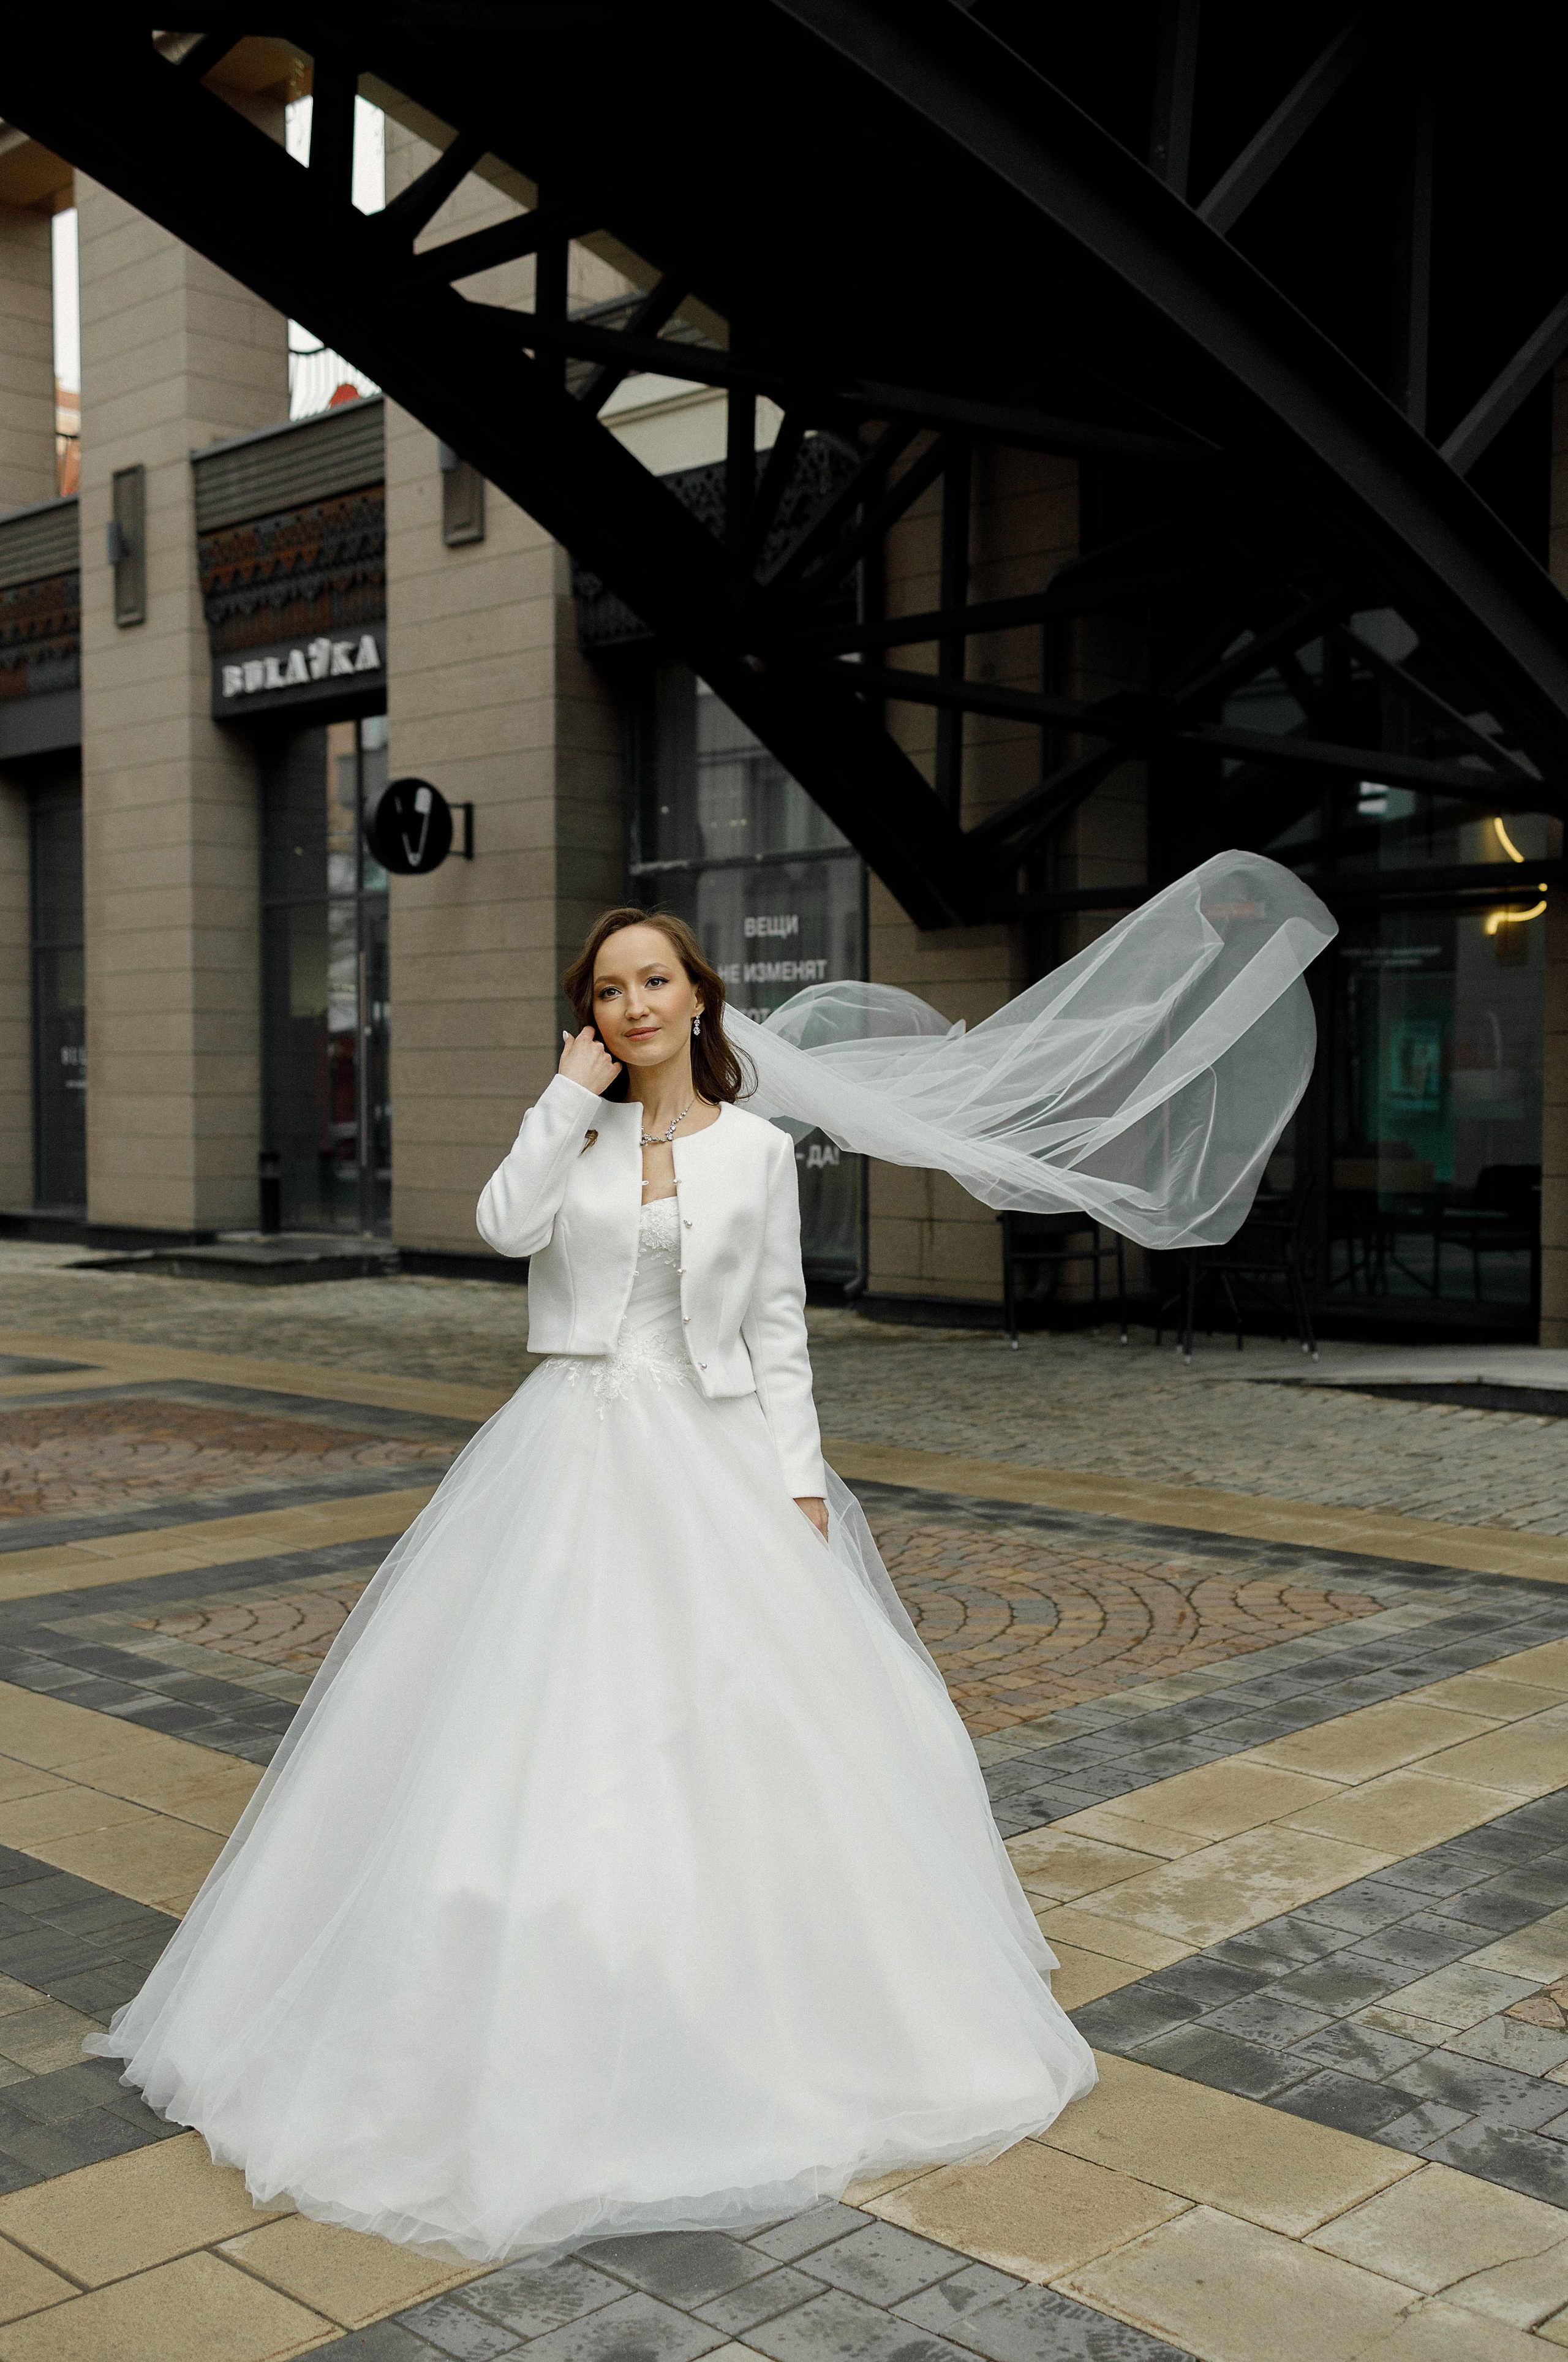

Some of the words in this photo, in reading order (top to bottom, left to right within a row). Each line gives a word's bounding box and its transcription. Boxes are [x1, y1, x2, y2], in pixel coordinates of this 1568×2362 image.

[744, 915, 799, 938] ВЕЩИ
[717, 962, 740, 984] НЕ
[743, 959, 827, 983] ИЗМЕНЯТ
[807, 1144, 840, 1169] ДА!
